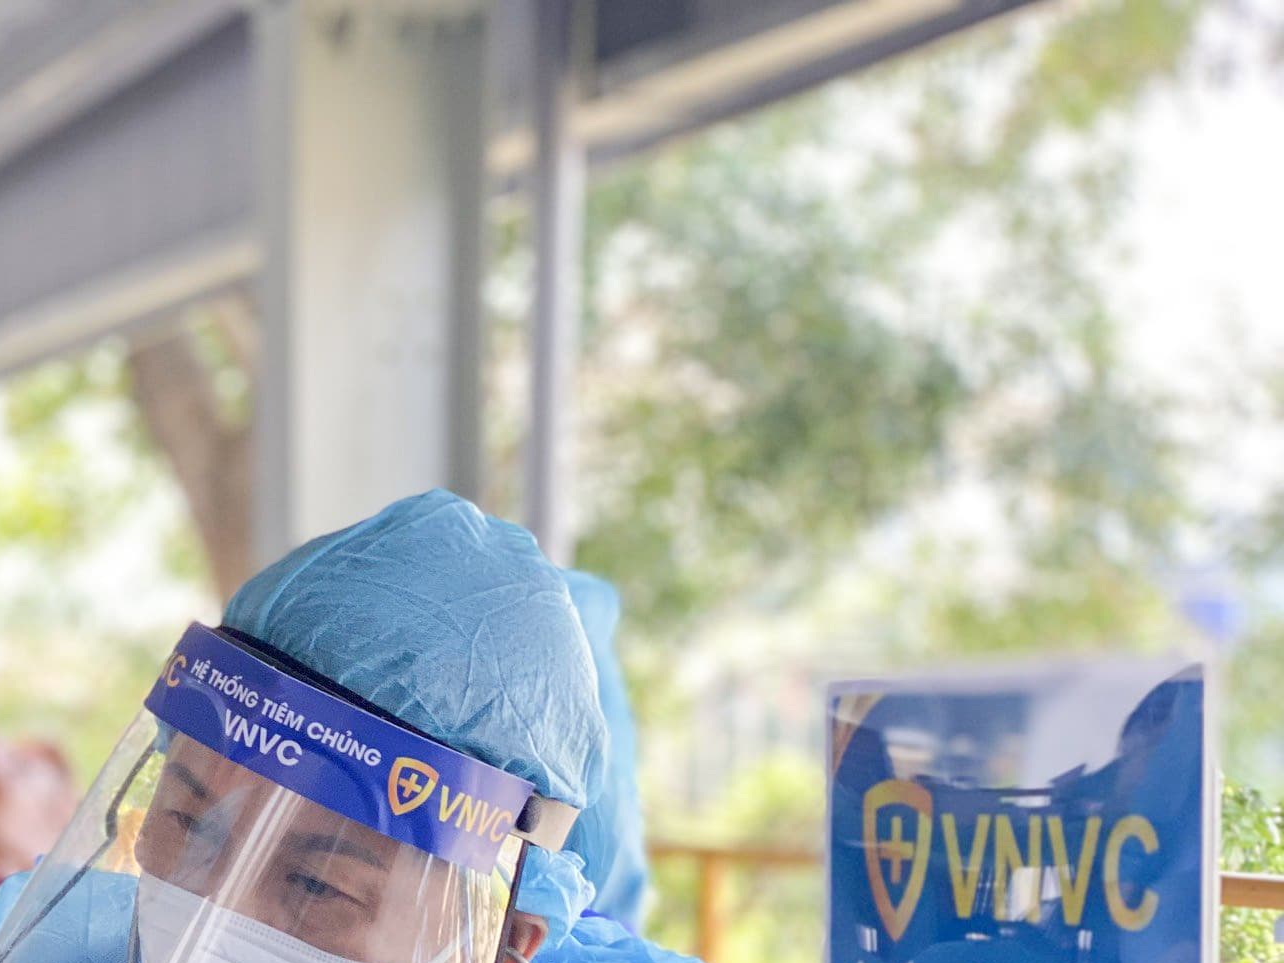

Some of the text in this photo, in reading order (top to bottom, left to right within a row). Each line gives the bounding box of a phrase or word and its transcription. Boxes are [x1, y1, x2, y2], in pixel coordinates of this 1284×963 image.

[190, 658, 382, 767] HỆ THỐNG TIÊM CHỦNG
[224, 708, 303, 766] VNVC
[439, 784, 513, 842] VNVC
[941, 812, 1160, 932] VNVC
